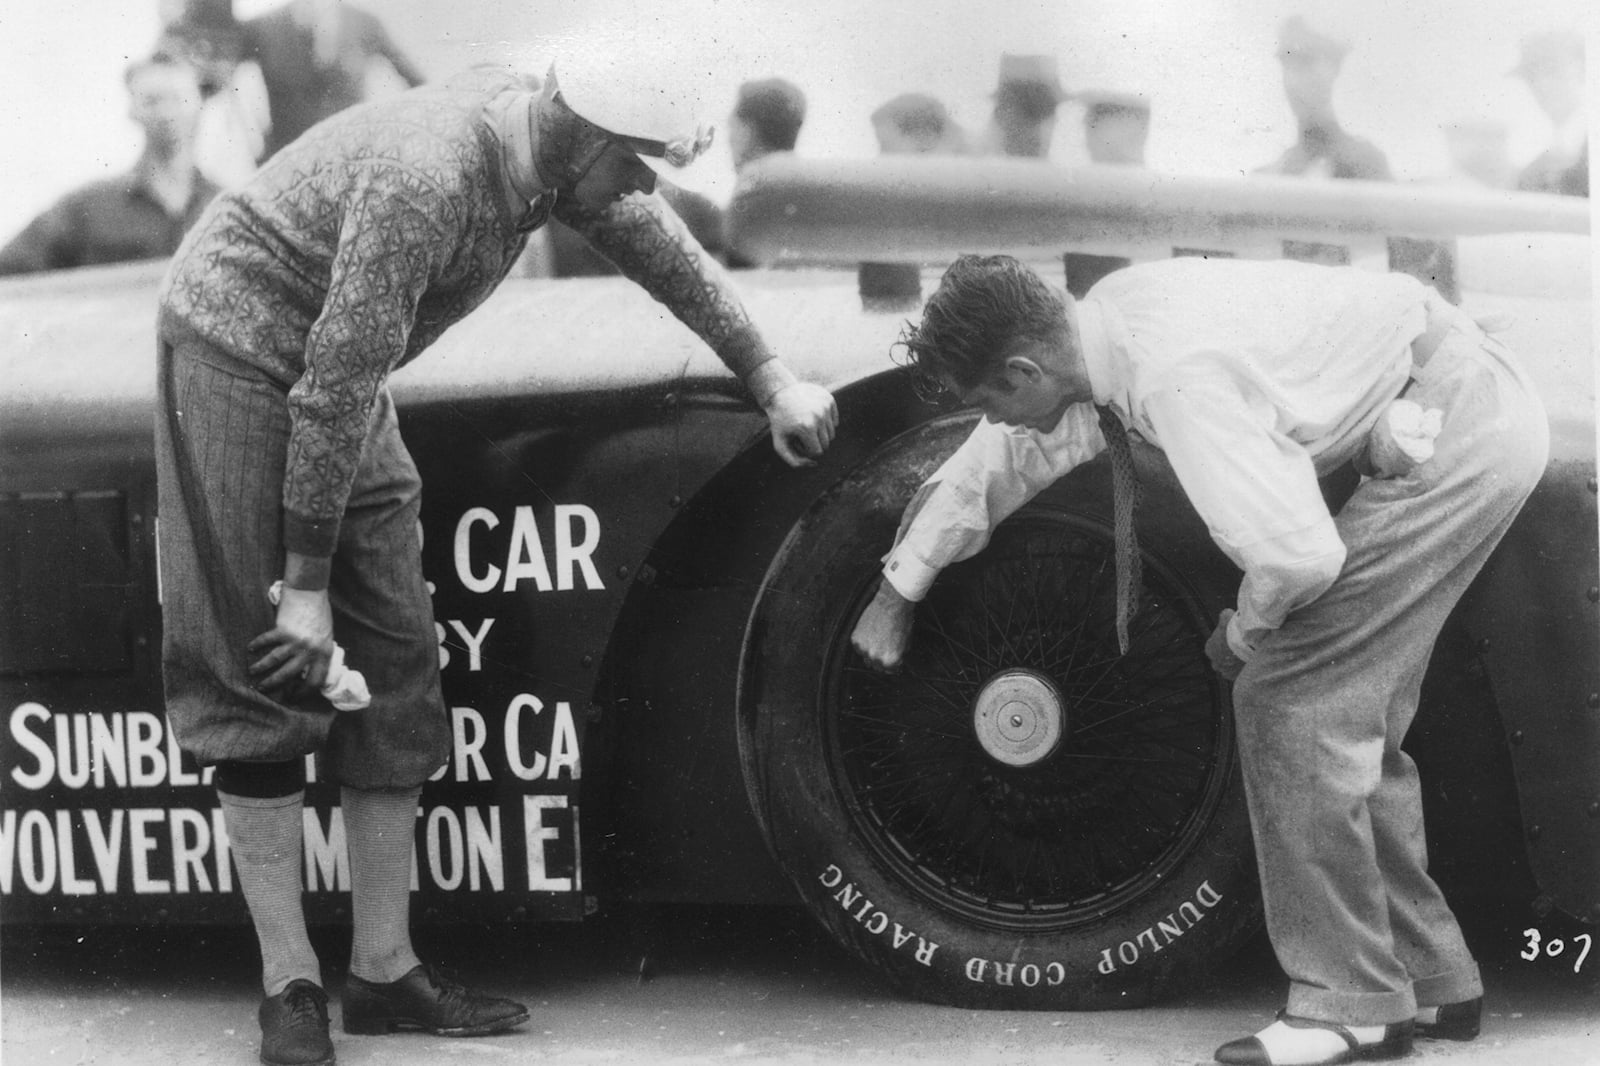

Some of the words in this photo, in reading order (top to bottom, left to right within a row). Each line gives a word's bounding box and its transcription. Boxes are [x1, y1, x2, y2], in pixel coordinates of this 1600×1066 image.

[454, 503, 606, 594] CAR
[818, 863, 940, 967] RACING
[1097, 879, 1224, 975] DUNLOP
[965, 956, 1066, 987] CORD
